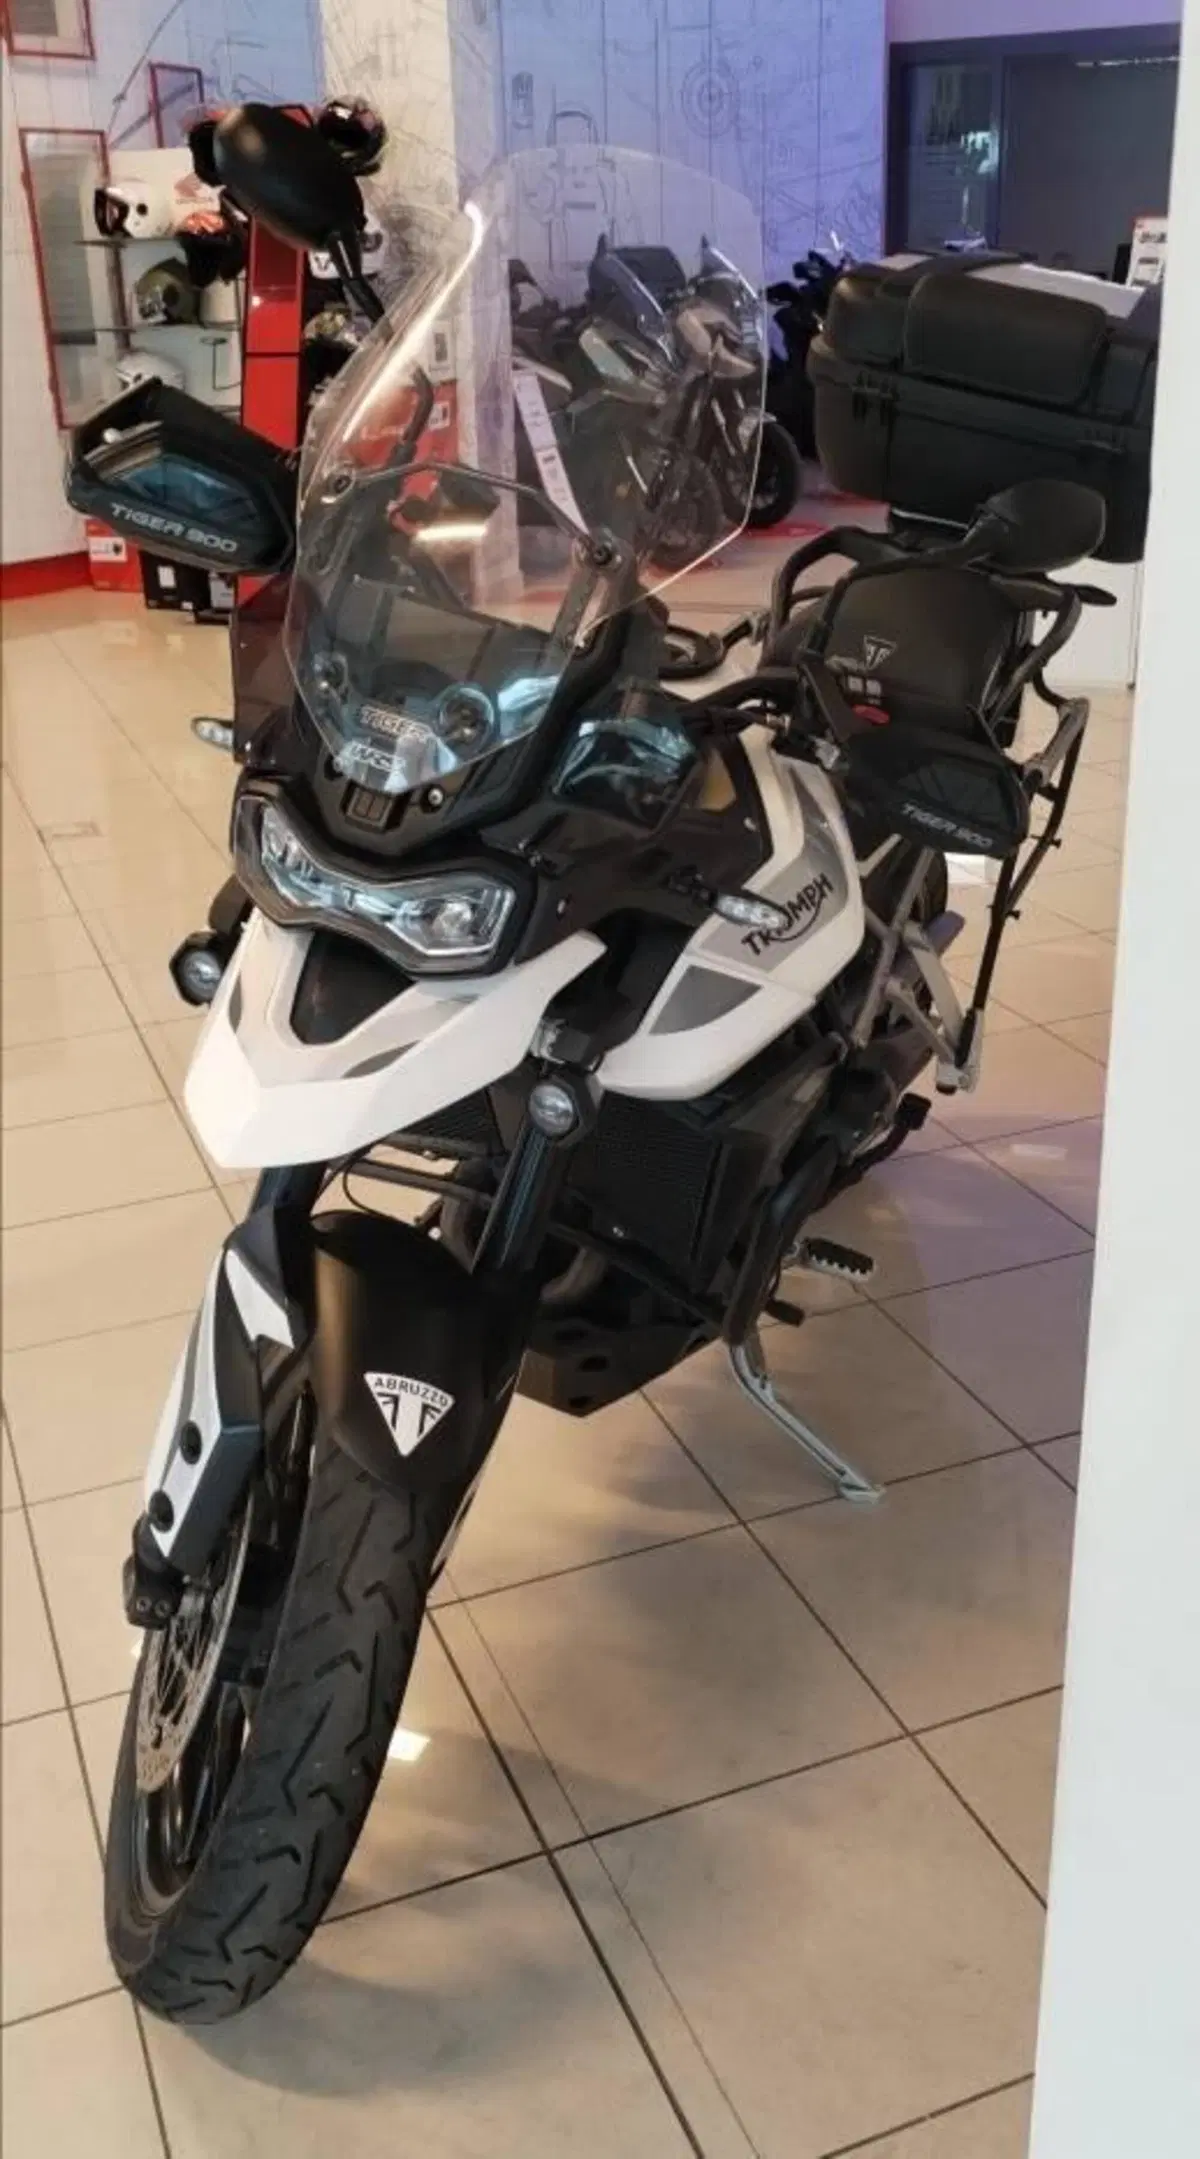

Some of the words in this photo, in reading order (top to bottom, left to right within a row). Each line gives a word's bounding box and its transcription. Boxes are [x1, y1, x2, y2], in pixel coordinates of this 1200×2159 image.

[111, 502, 186, 537] TIGER
[185, 527, 238, 553] 900
[373, 1377, 449, 1408] ABRUZZO
